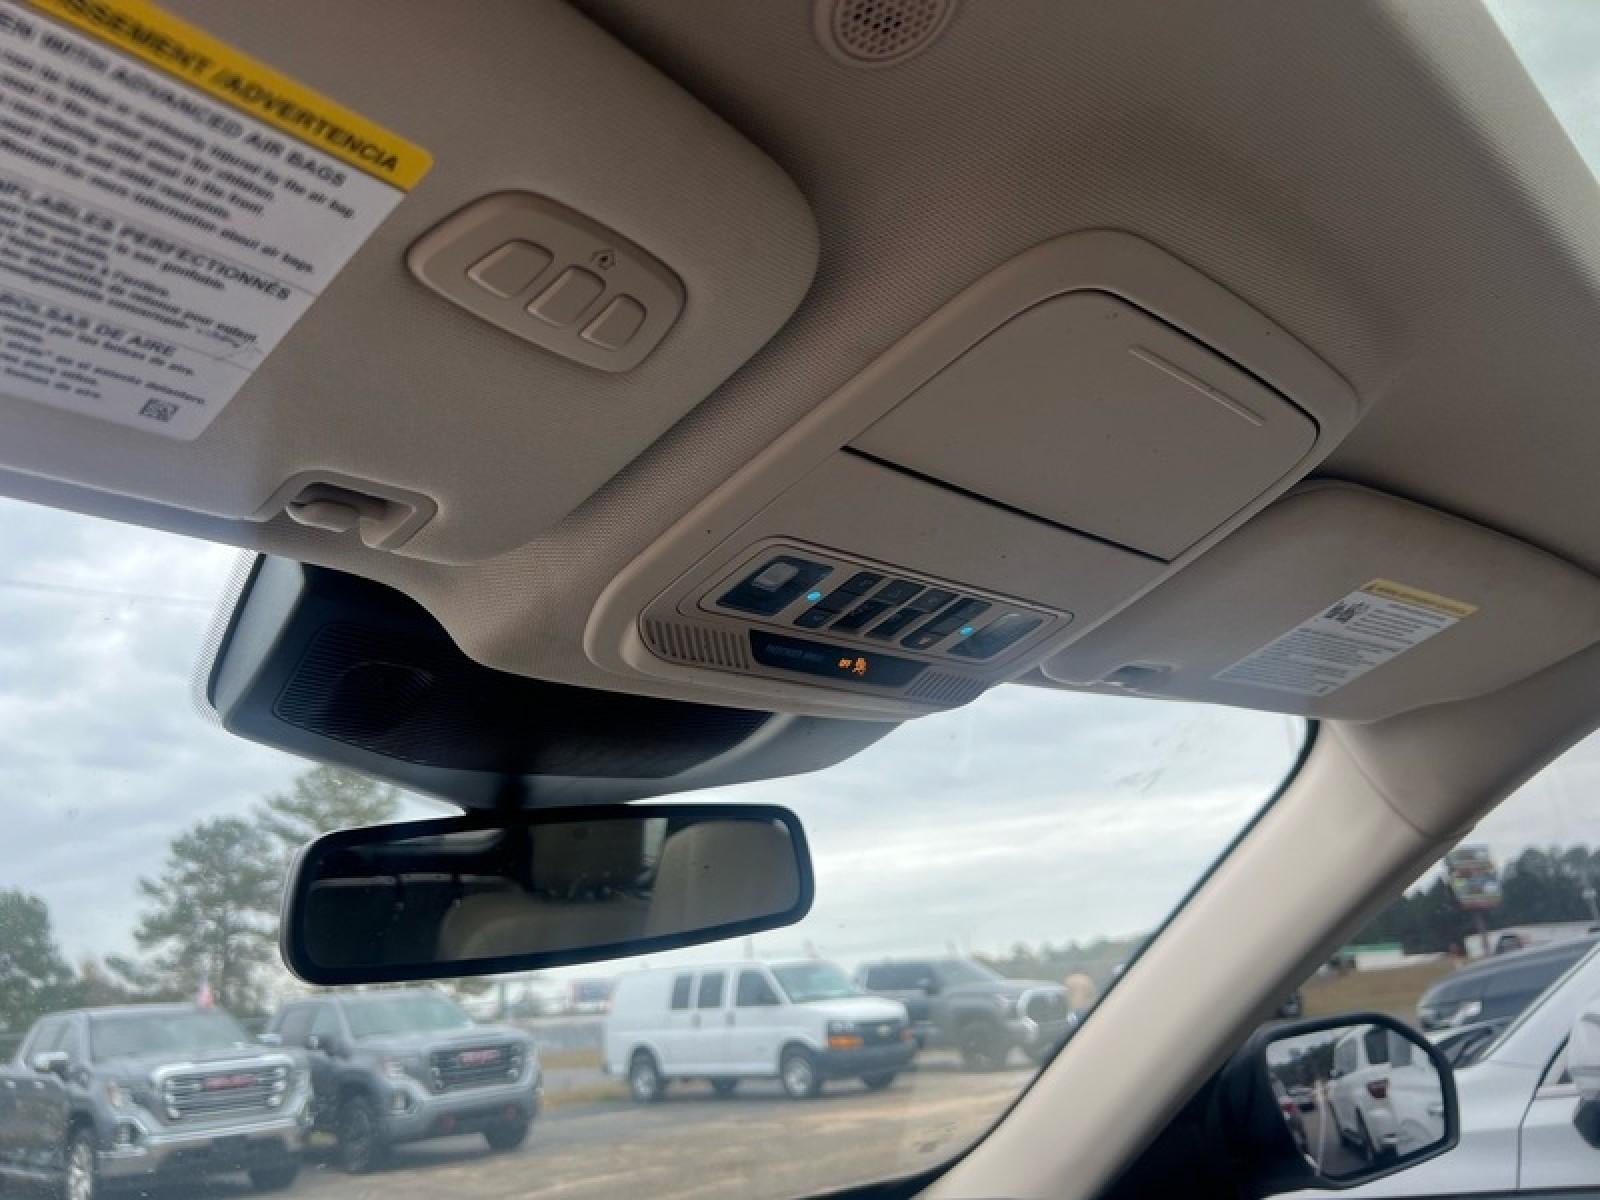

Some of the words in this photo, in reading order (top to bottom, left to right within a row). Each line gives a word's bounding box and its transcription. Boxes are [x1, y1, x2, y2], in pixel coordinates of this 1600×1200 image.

[41, 34, 106, 70] WITH
[112, 68, 241, 136] ADVANCED
[246, 132, 283, 156] AIR
[288, 150, 346, 186] BAGS
[119, 226, 291, 299] PERFECTIONNÉS
